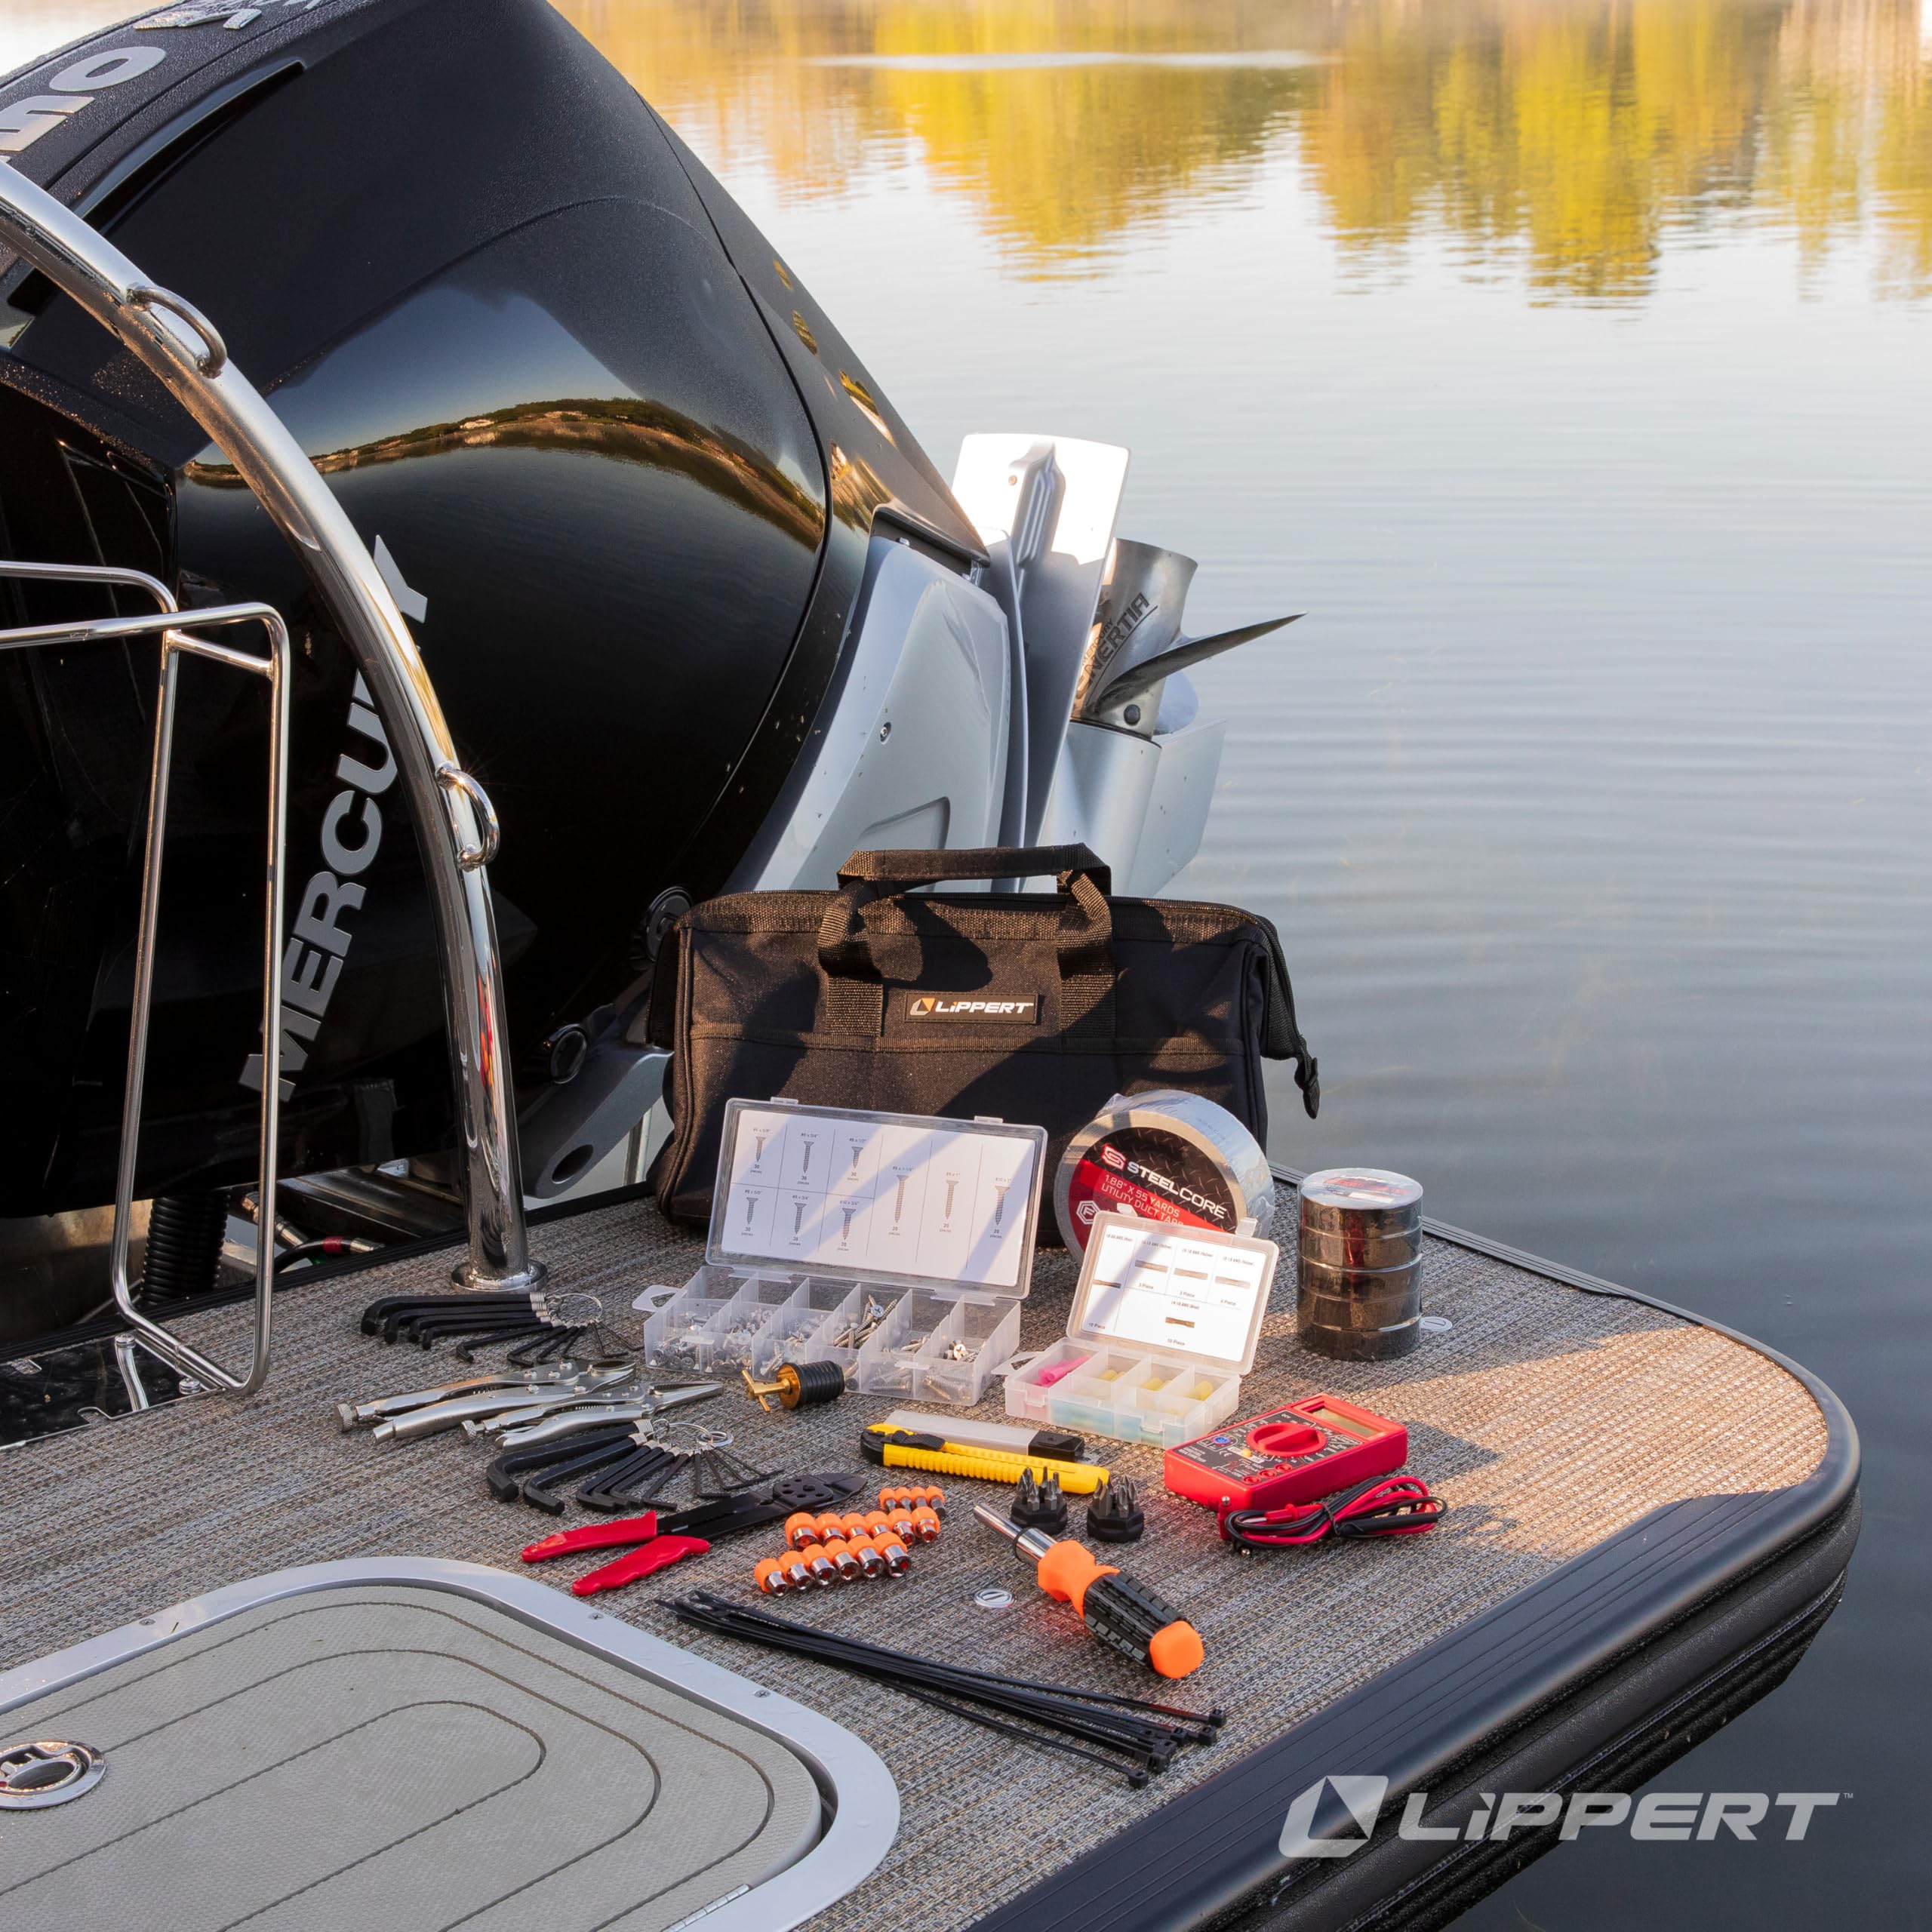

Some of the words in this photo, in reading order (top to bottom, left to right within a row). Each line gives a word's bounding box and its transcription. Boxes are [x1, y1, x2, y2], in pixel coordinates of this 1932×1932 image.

[238, 534, 429, 1103] MERCUY
[1101, 1183, 1134, 1203] UTILITY
[1134, 1200, 1158, 1216] DUCT
[1127, 1161, 1227, 1220] STEELCORE
[1136, 1190, 1148, 1201] 55
[1149, 1197, 1180, 1218] YARDS
